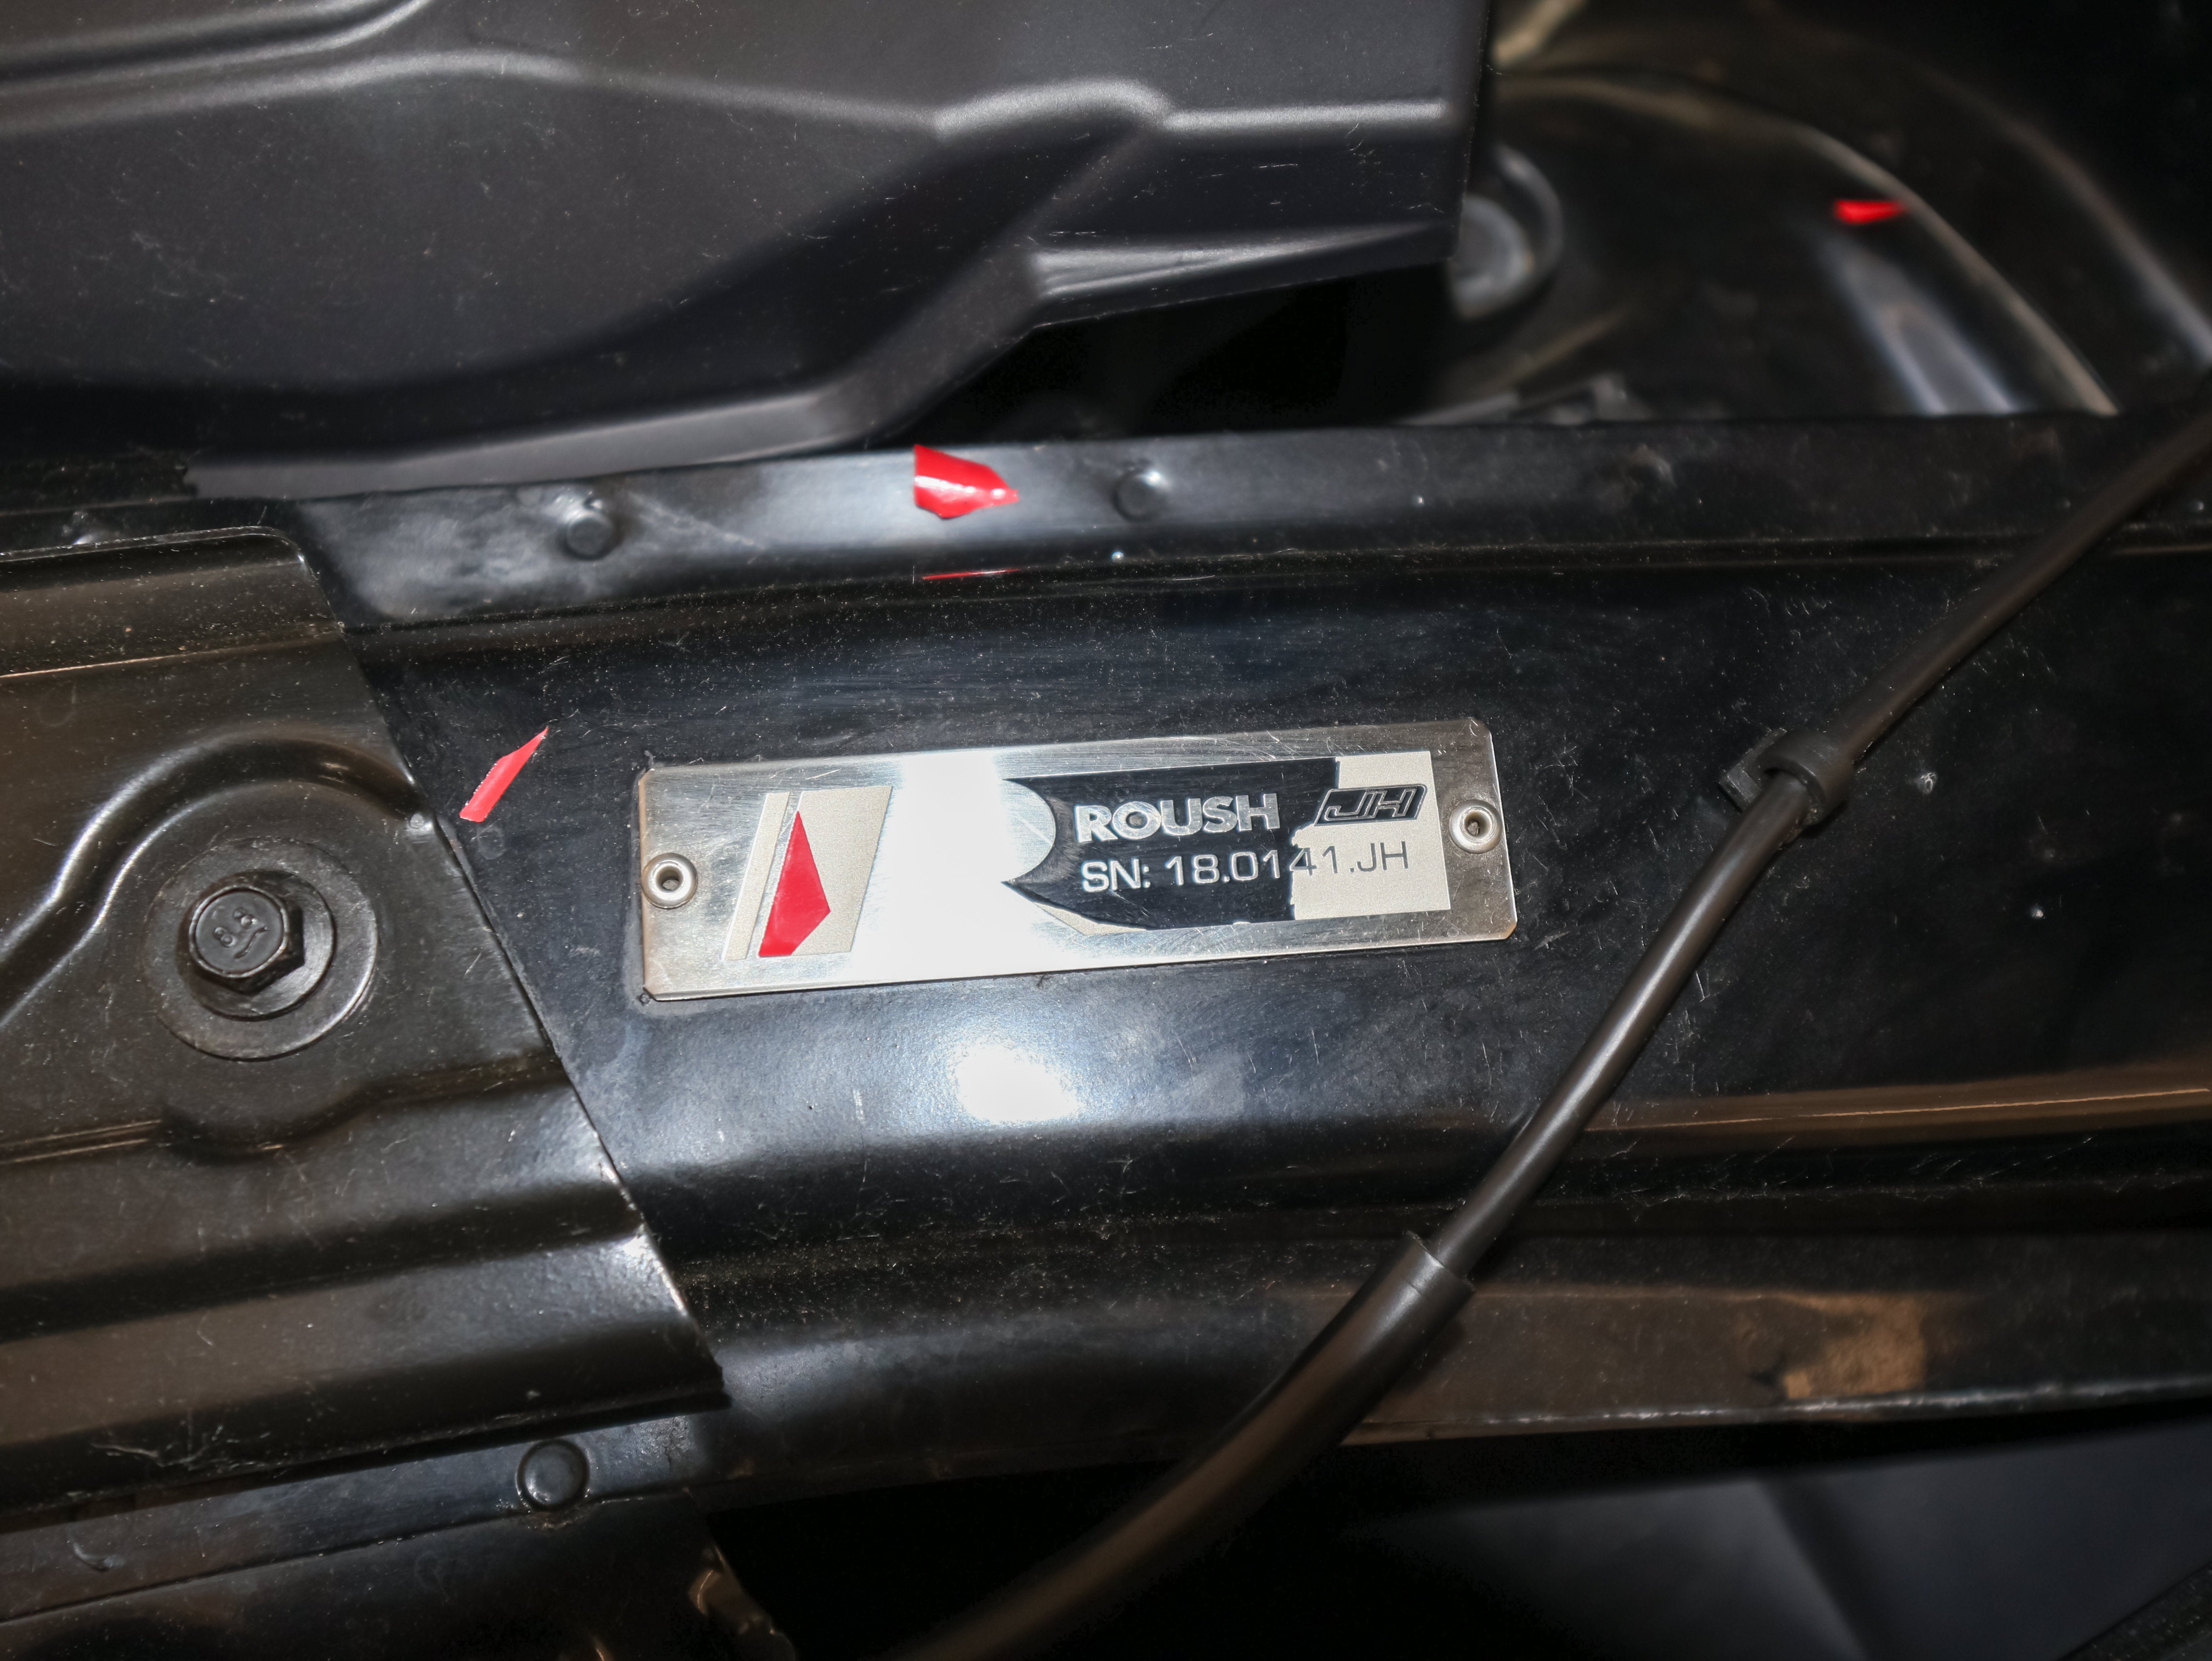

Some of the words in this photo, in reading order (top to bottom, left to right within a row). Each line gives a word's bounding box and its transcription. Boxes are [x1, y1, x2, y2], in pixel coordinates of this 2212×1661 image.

[1075, 793, 1281, 843] ROUSH
[1082, 858, 1151, 892] SN:
[1165, 840, 1409, 886] 18.0141.JH
